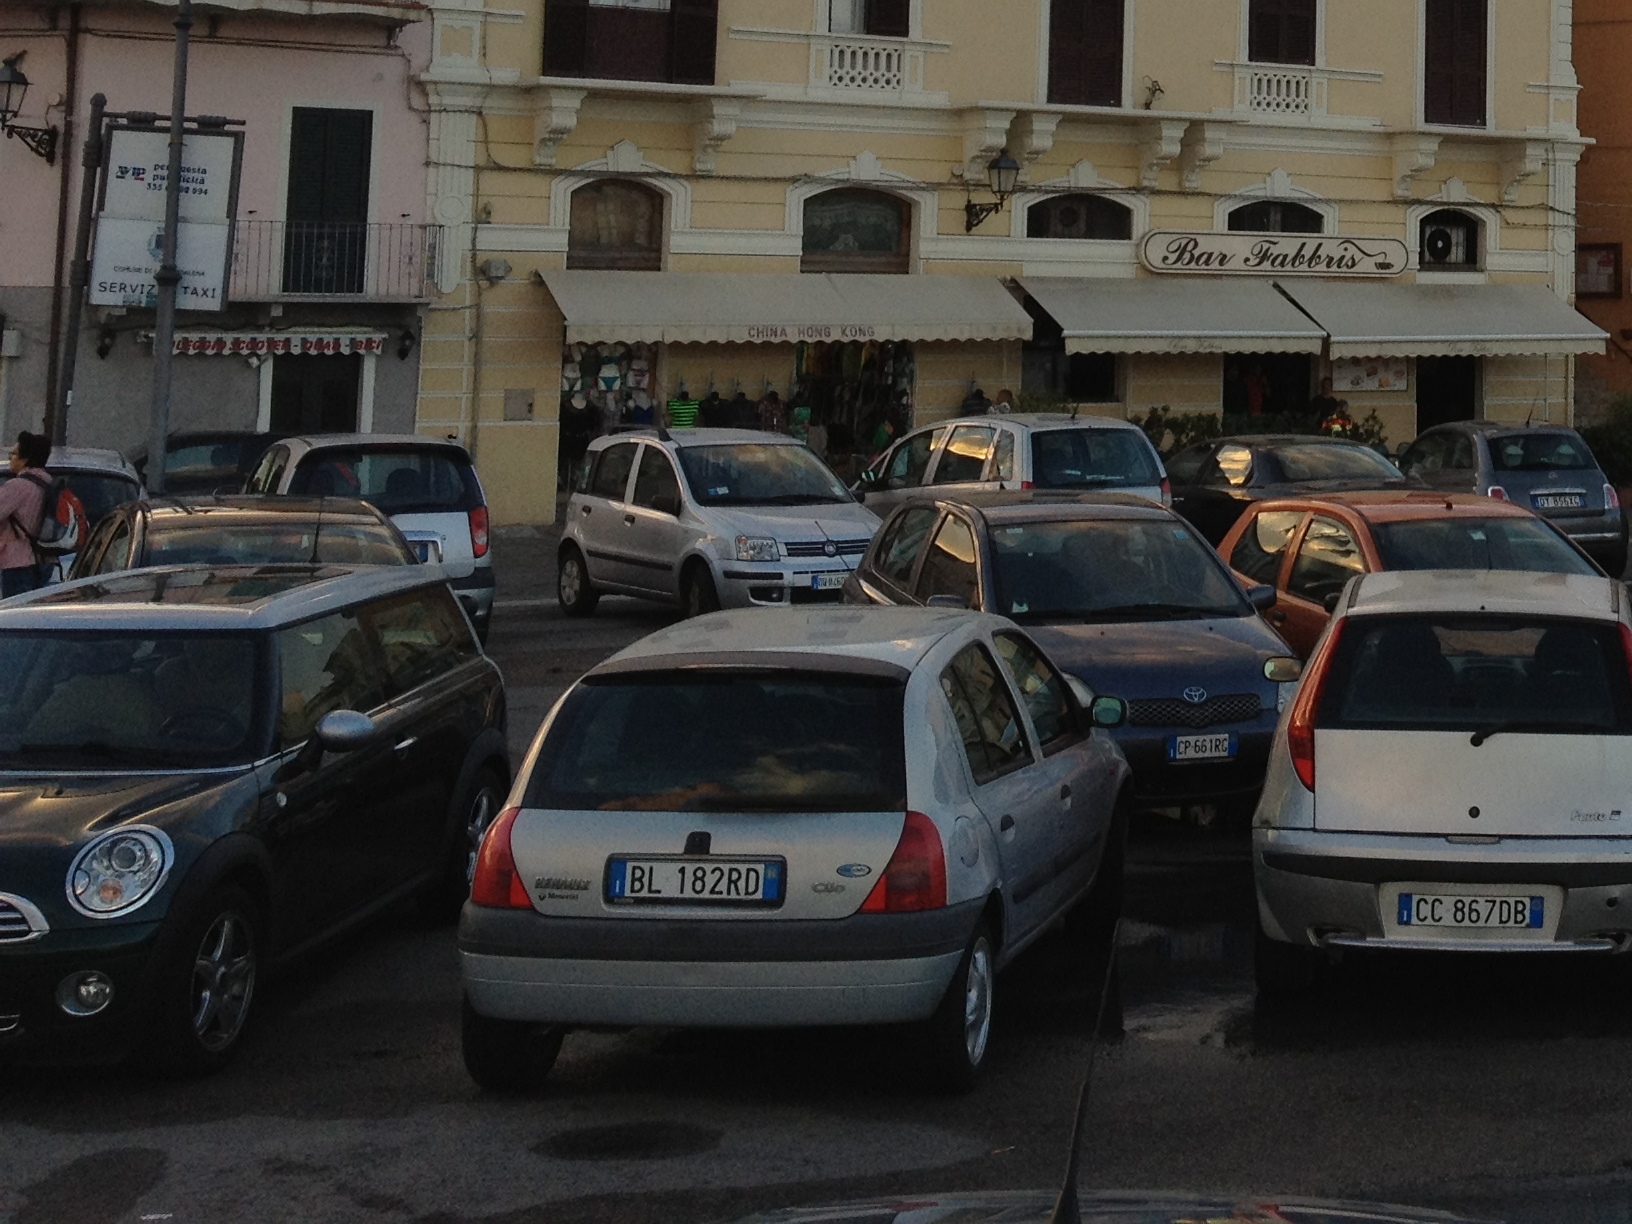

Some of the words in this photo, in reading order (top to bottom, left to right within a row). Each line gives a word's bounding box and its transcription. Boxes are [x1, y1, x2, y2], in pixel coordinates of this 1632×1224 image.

[1162, 236, 1236, 267] Bar
[1243, 239, 1363, 270] Fabbris
[182, 285, 217, 299] TAXI
[748, 326, 788, 339] CHINA
[798, 327, 832, 338] HONG
[841, 326, 875, 338] KONG
[1177, 739, 1192, 756] CP
[629, 866, 662, 895] BL
[677, 865, 761, 896] 182RD
[1415, 897, 1444, 923] CC
[1452, 898, 1527, 926] 867DB
